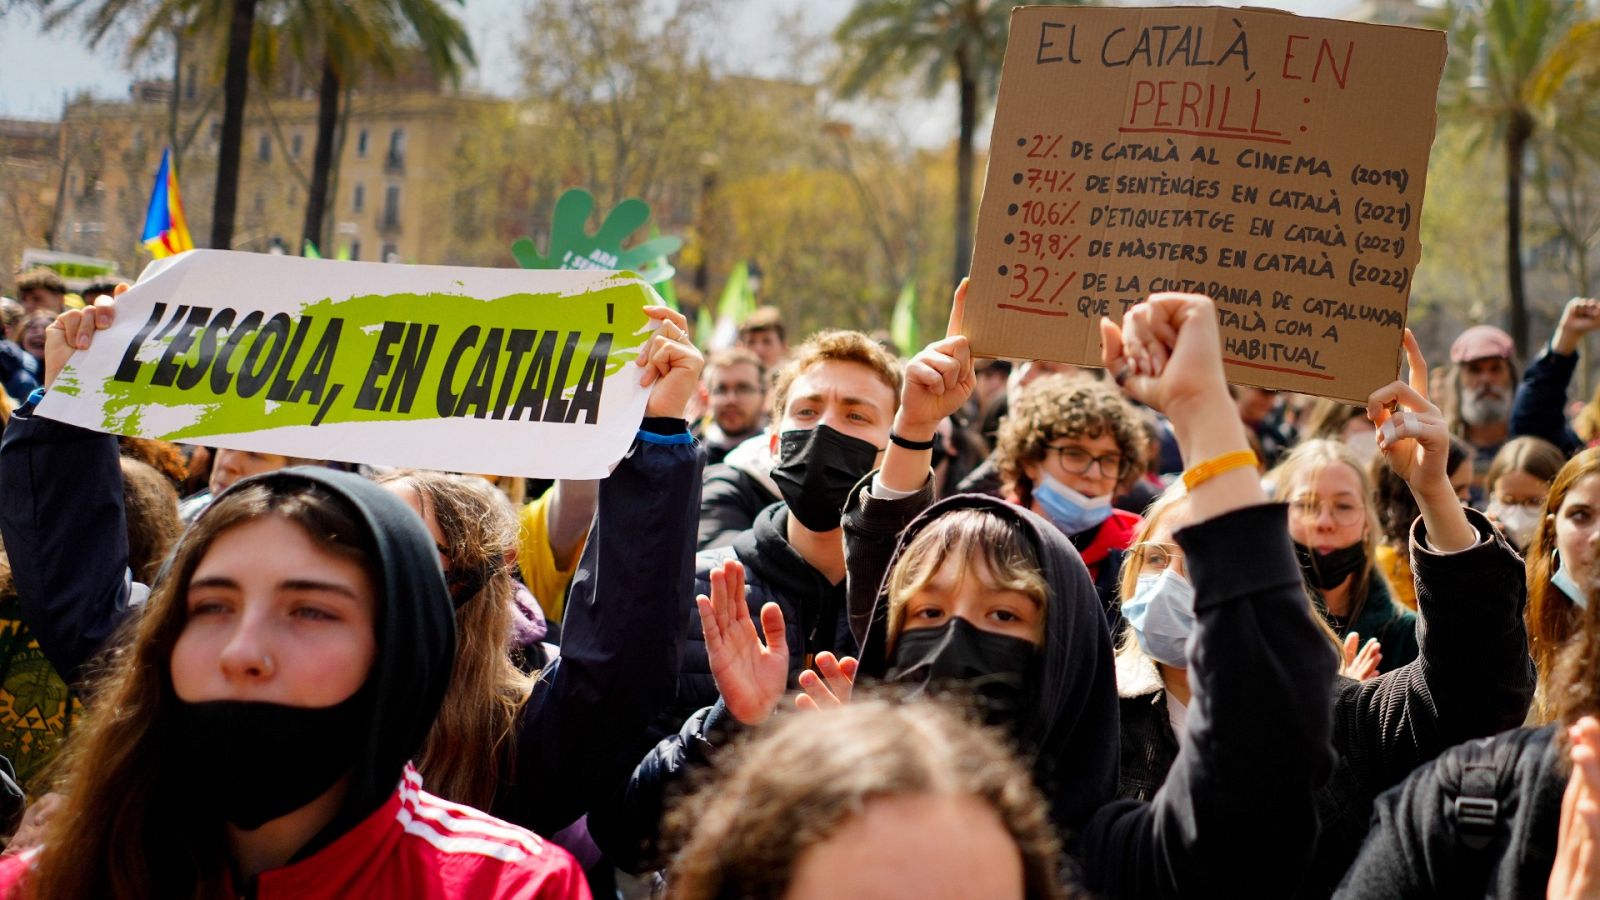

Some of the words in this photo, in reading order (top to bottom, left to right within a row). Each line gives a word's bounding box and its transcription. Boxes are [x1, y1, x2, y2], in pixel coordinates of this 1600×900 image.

[1101, 18, 1256, 82] CATALÀ,
[1283, 35, 1354, 89] EN
[1026, 134, 1063, 159] 2%
[1070, 140, 1094, 160] DE
[1101, 138, 1179, 162] CATALÀ
[1190, 146, 1220, 165] AL
[1236, 149, 1332, 178] CINEMA
[1351, 164, 1409, 195] (2019)
[1021, 200, 1081, 227] 10,6%
[1089, 204, 1235, 233] D'ETIQUETATGE
[1249, 217, 1275, 238] EN
[1284, 224, 1347, 247] CATALÀ
[1355, 231, 1405, 259] (2021)
[1027, 168, 1076, 193] 7,4%
[1085, 174, 1110, 194] DE
[1231, 184, 1259, 204] EN
[1269, 189, 1341, 216] CATALÀ
[1355, 197, 1411, 231] (2021)
[1017, 230, 1081, 260] 39,8%
[1088, 239, 1113, 257] DE
[1117, 238, 1208, 264] MÀSTERS
[1217, 248, 1247, 269] EN
[1253, 251, 1335, 279] CATALÀ
[1349, 258, 1409, 293] (2022)
[1010, 264, 1077, 306] 32%
[1082, 272, 1108, 292] DE
[1115, 275, 1140, 293] LA
[1271, 290, 1293, 311] DE
[1302, 297, 1403, 329] CATALUNYA
[1077, 296, 1110, 318] QUE
[1275, 319, 1312, 336] COM
[1321, 325, 1338, 342] A
[114, 302, 344, 426] L'ESCOLA,
[353, 321, 439, 414] EN
[436, 303, 614, 425] CATALÀ
